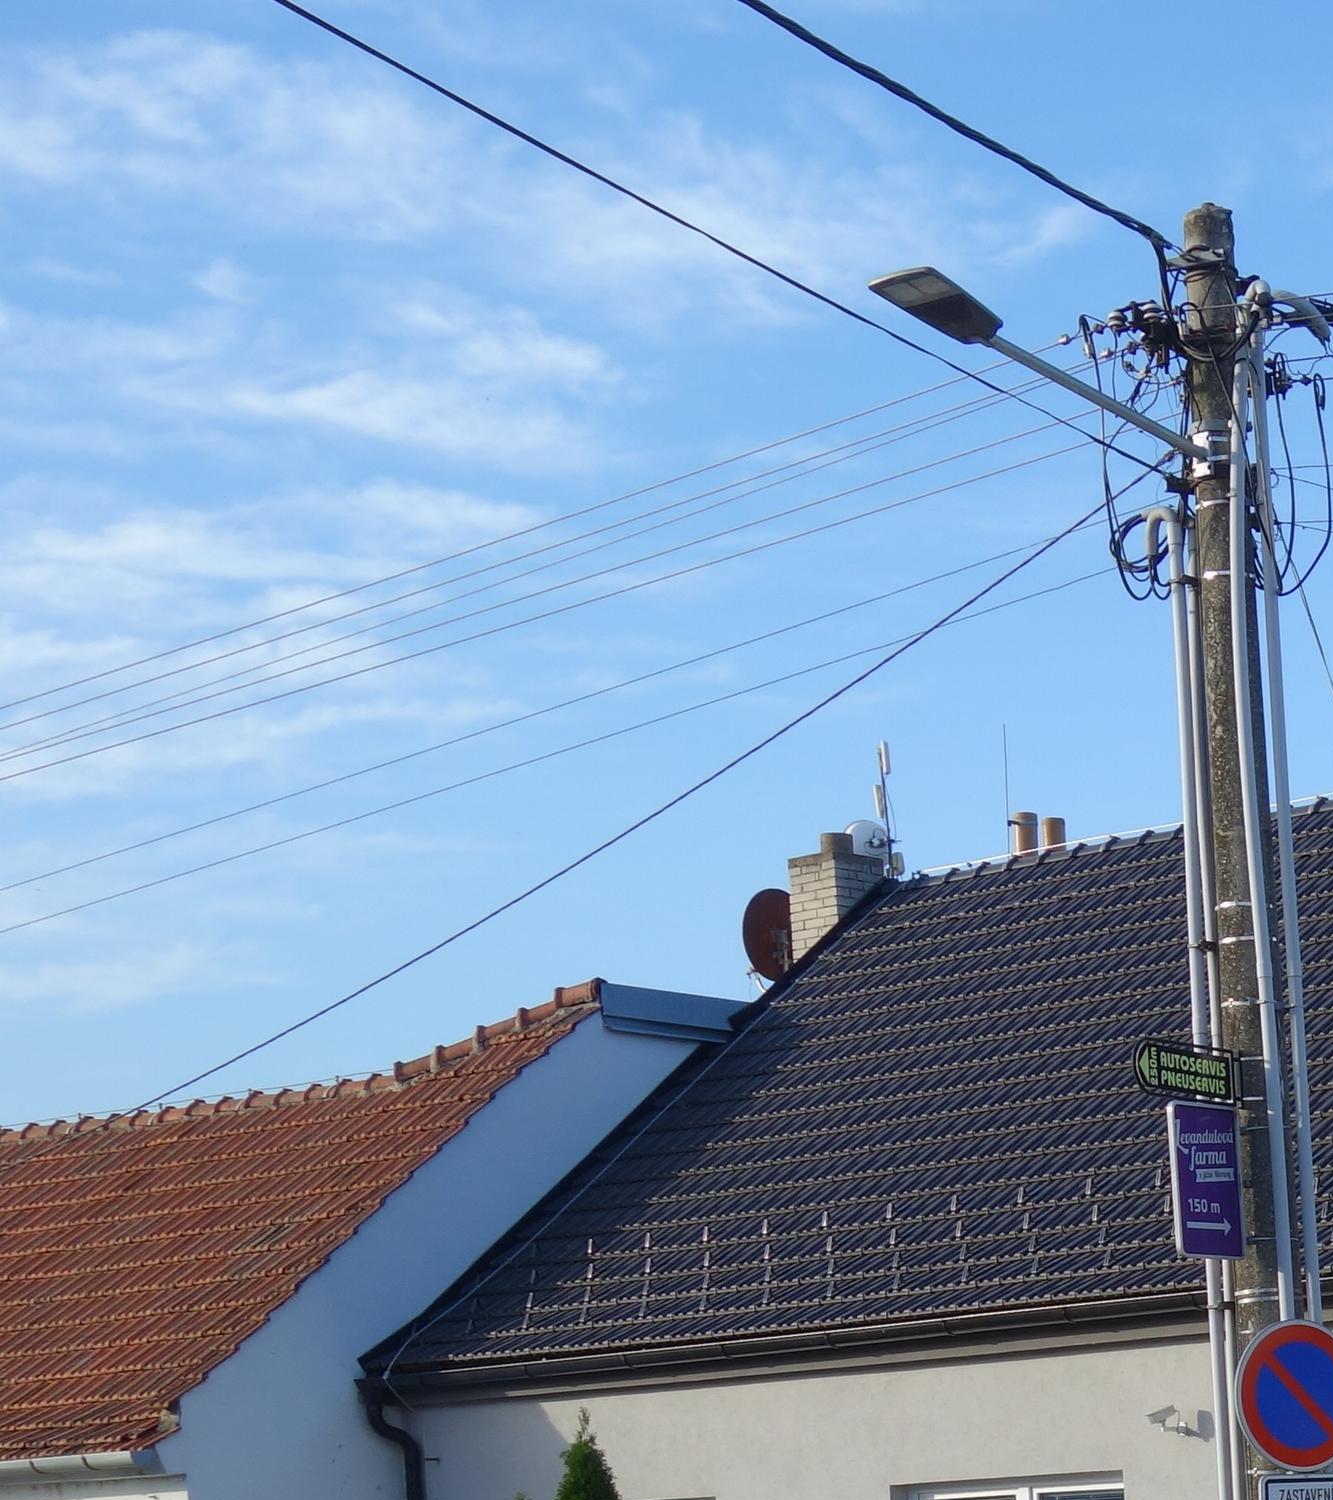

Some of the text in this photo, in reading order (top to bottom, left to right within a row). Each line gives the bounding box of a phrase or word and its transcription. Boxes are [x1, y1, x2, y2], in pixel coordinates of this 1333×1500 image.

[1160, 1051, 1226, 1077] AUTOSERVIS
[1160, 1070, 1226, 1095] PNEUSERVIS
[1174, 1119, 1233, 1154] Levandulová
[1189, 1146, 1227, 1171] farma
[1188, 1198, 1221, 1213] 150 m
